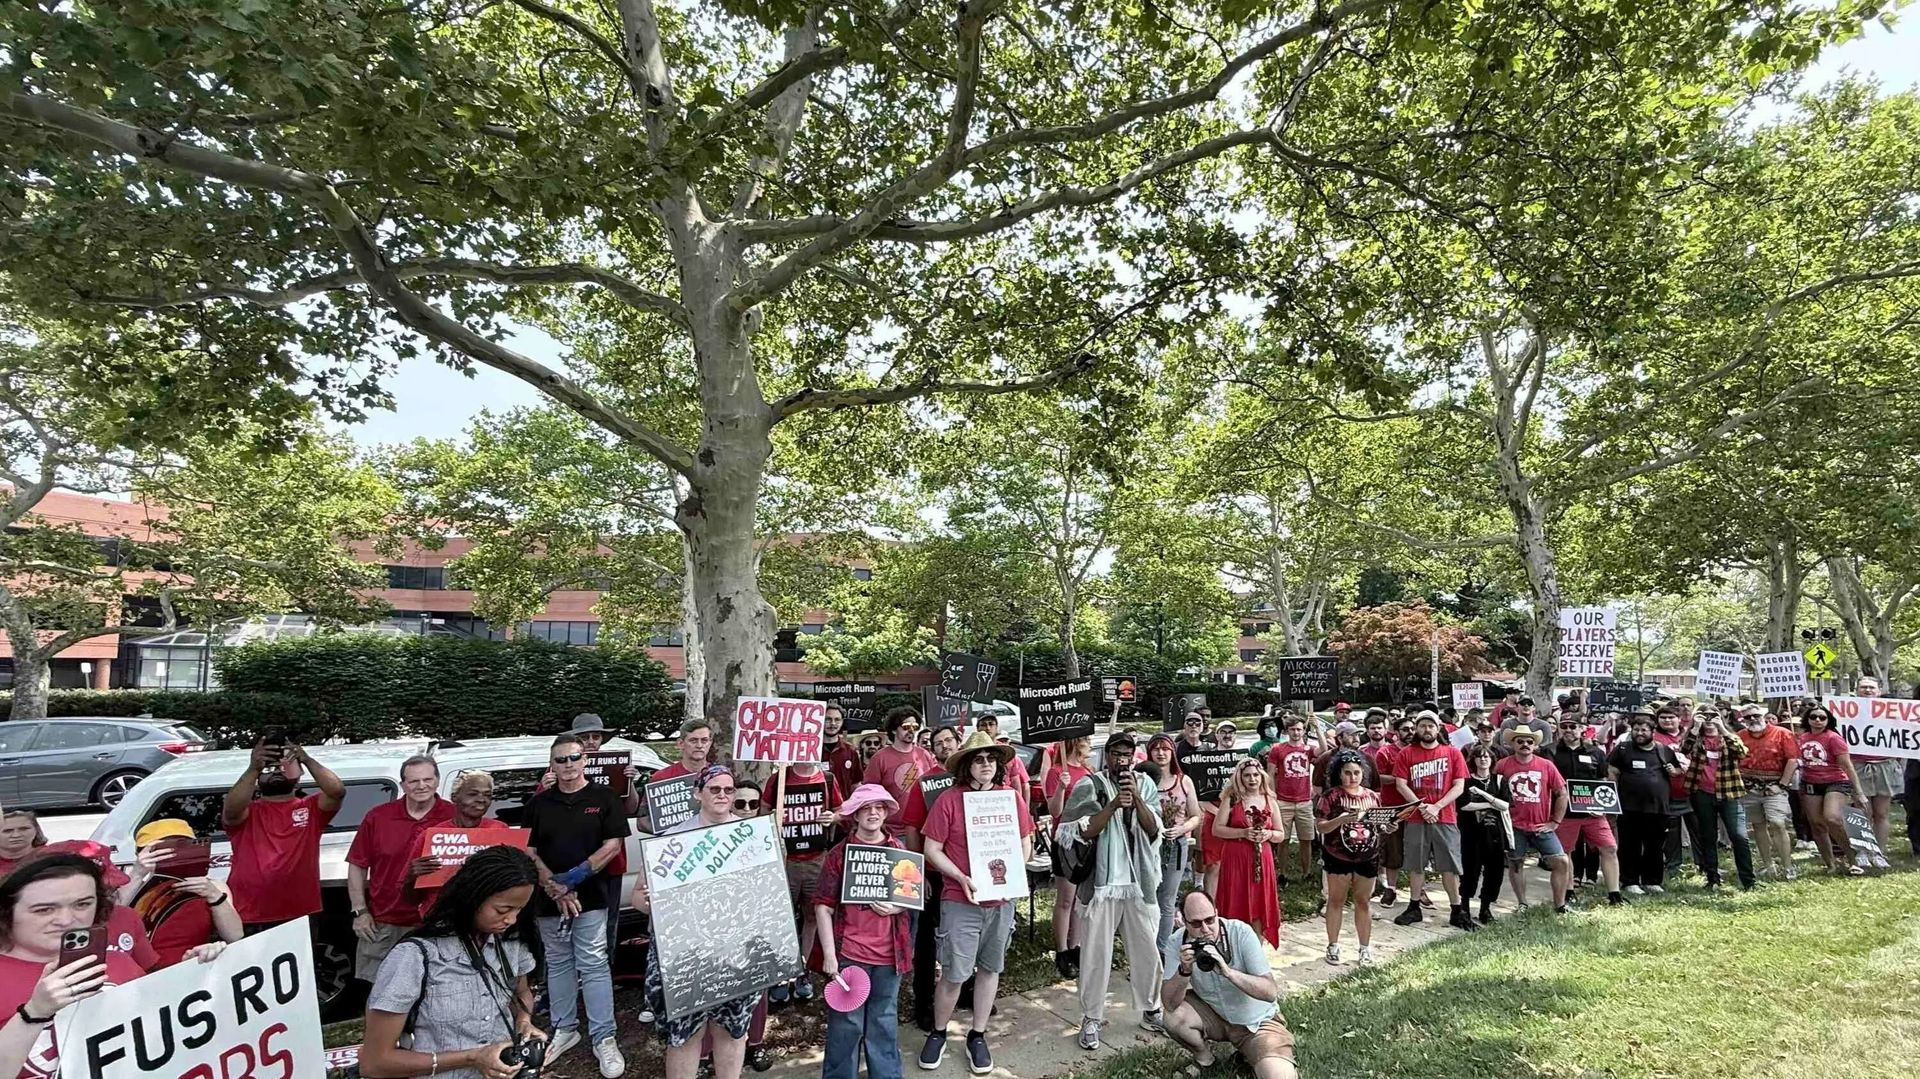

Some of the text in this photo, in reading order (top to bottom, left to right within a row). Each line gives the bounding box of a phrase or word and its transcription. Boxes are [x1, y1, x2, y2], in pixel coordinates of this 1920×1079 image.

[1573, 612, 1604, 626] OUR
[1561, 628, 1615, 642] PLAYERS
[1560, 644, 1613, 658] DESERVE
[1706, 659, 1736, 668] CHANGES
[1760, 655, 1797, 665] RECORD
[1560, 660, 1613, 674] BETTER
[1706, 667, 1732, 676] NEITHER
[1761, 665, 1800, 674] PROFITS
[1292, 680, 1327, 688] LAYOFF
[1699, 678, 1735, 689] CORPORATE
[1763, 674, 1801, 684] RECORD
[815, 683, 876, 694] Microsoft Runs
[1019, 681, 1091, 699] Microsoft Runs
[1705, 686, 1726, 694] GREED
[1764, 684, 1804, 693] LAYOFFS
[839, 696, 861, 705] Trust
[1605, 692, 1627, 703] For
[1038, 697, 1077, 713] on Trust
[1828, 699, 1920, 723] NO DEVS
[738, 701, 825, 736] CHOICES
[1863, 725, 1920, 750] GAMES
[736, 730, 821, 762] MATTER
[597, 756, 618, 766] RUNS
[618, 756, 629, 764] ON
[1191, 752, 1231, 764] Microsoft
[1207, 767, 1218, 776] on
[654, 790, 692, 807] LAYOFFS
[809, 791, 823, 803] WE
[660, 801, 689, 817] NEVER
[971, 814, 1013, 825] BETTER
[801, 823, 823, 837] WIN
[431, 833, 469, 844] CWA
[705, 822, 754, 875] DOLLARS
[652, 837, 684, 879] DEVS
[673, 829, 720, 882] BEFORE
[848, 850, 894, 864] LAYOFFS...
[851, 861, 890, 875] LAYOFFS
[855, 874, 885, 886] NEVER
[850, 885, 889, 898] CHANGE
[86, 952, 300, 1079] FUS RO
